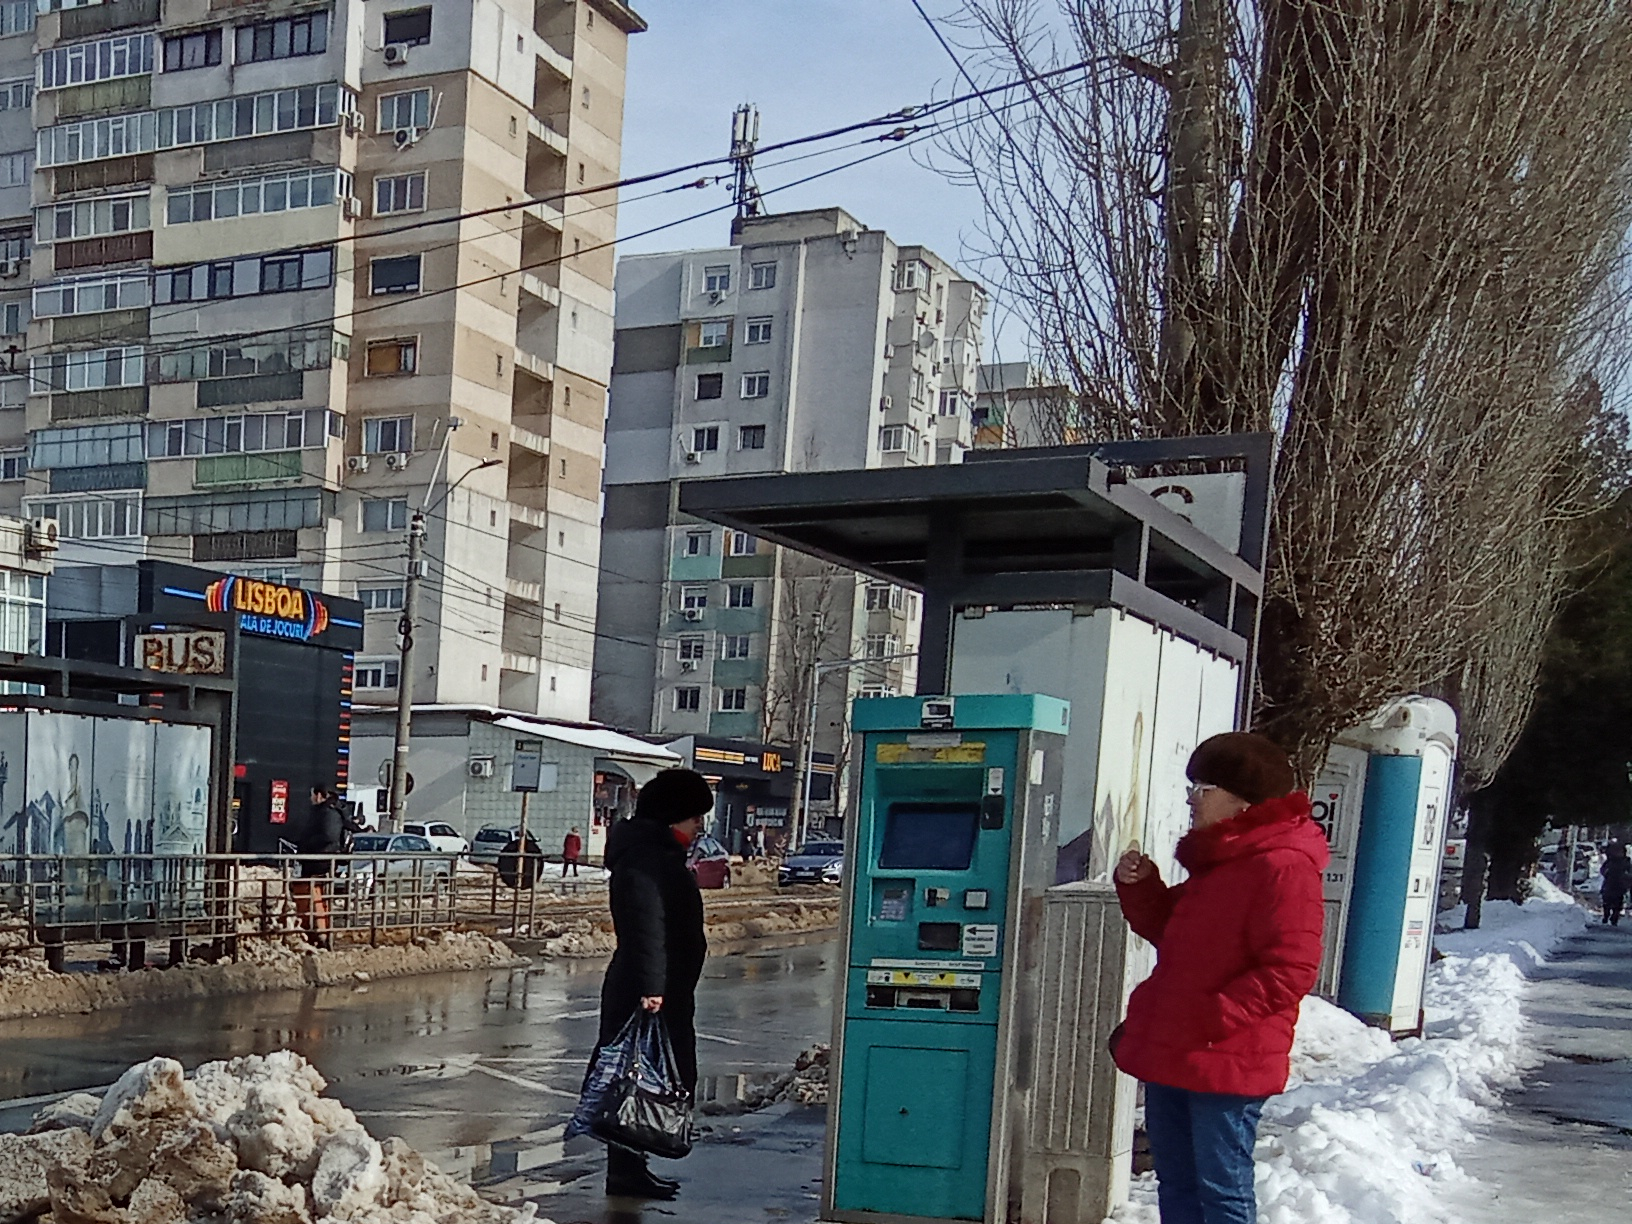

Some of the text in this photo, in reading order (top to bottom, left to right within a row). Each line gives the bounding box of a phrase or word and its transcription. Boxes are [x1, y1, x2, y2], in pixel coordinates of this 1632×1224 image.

[235, 578, 304, 620] LISBOA
[240, 614, 304, 638] ALĂ DE JOCURI
[143, 636, 215, 671] BUS
[762, 752, 781, 772] LUCA
[1326, 872, 1343, 883] 131
